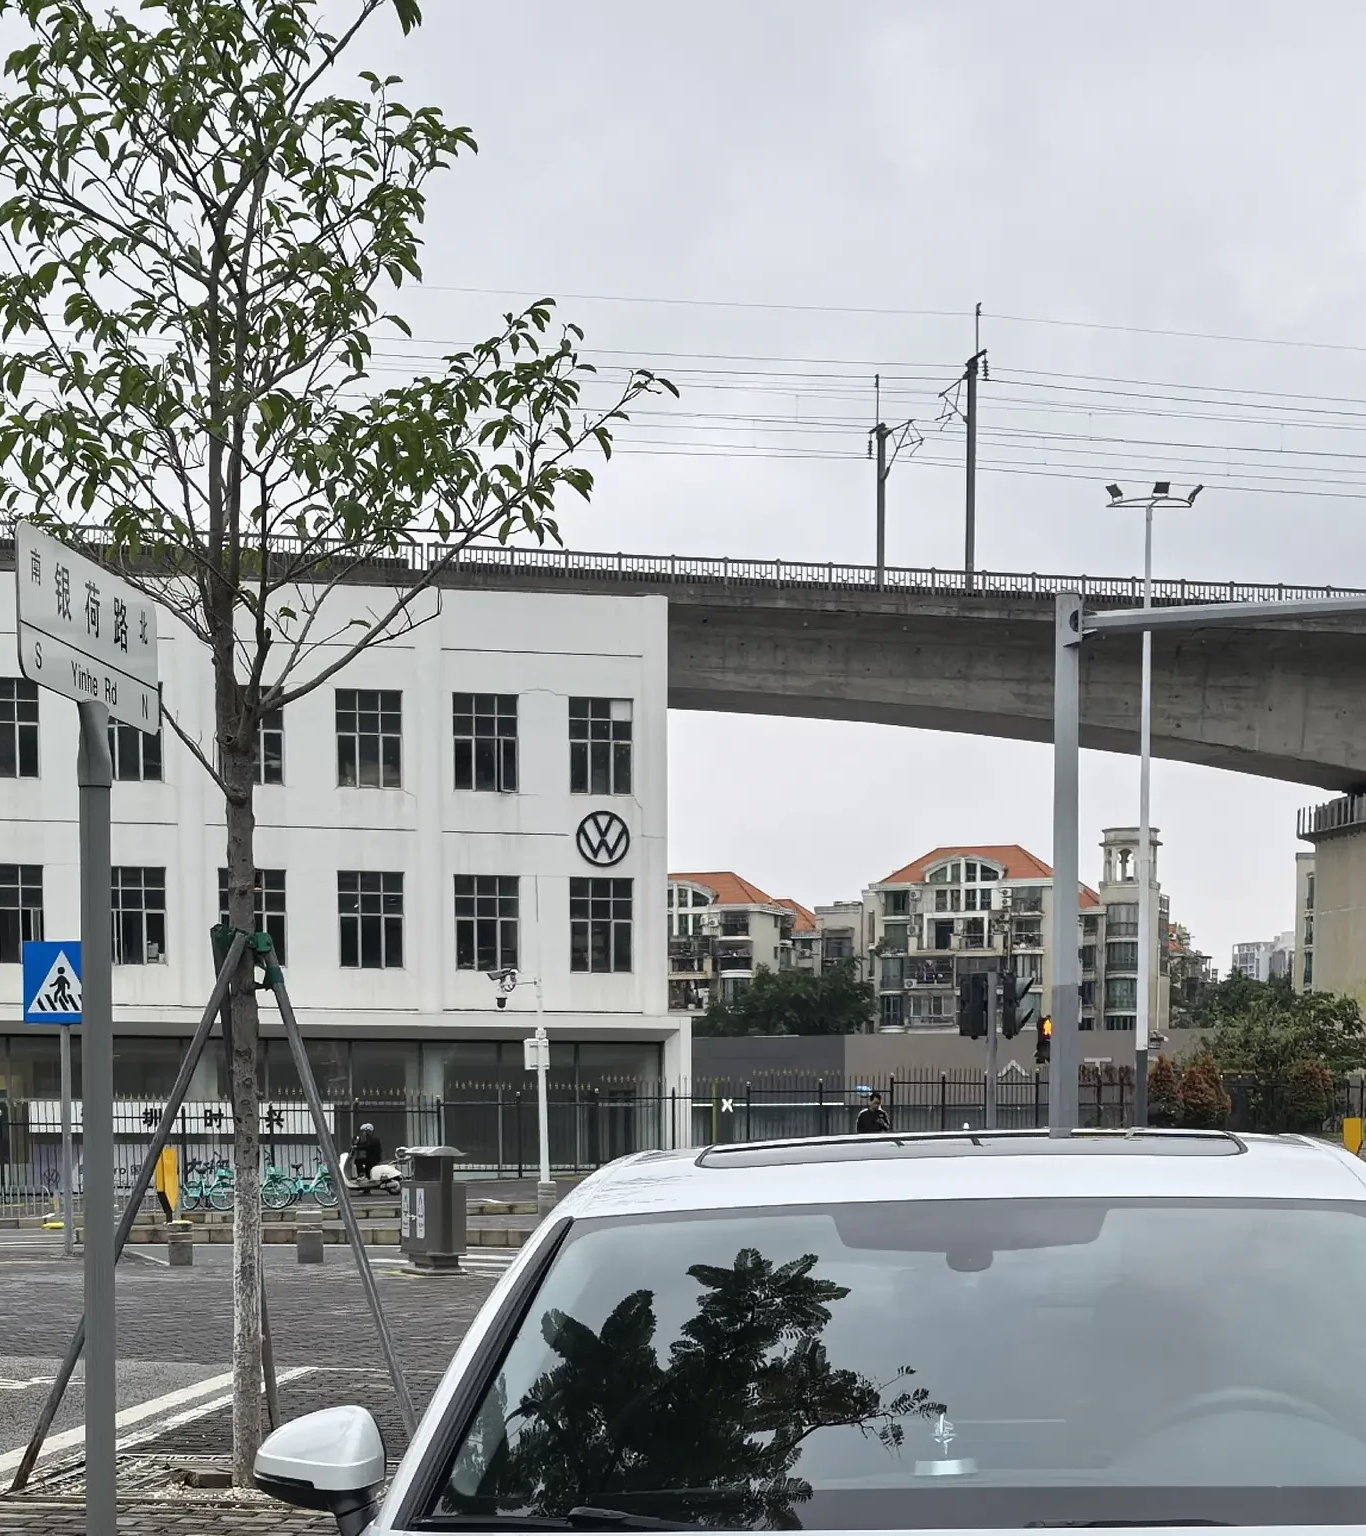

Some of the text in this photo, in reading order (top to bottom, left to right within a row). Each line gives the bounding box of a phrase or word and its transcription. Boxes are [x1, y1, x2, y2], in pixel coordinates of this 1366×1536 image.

[54, 562, 128, 653] 银荷路
[35, 641, 149, 720] S Yinhe Rd N
